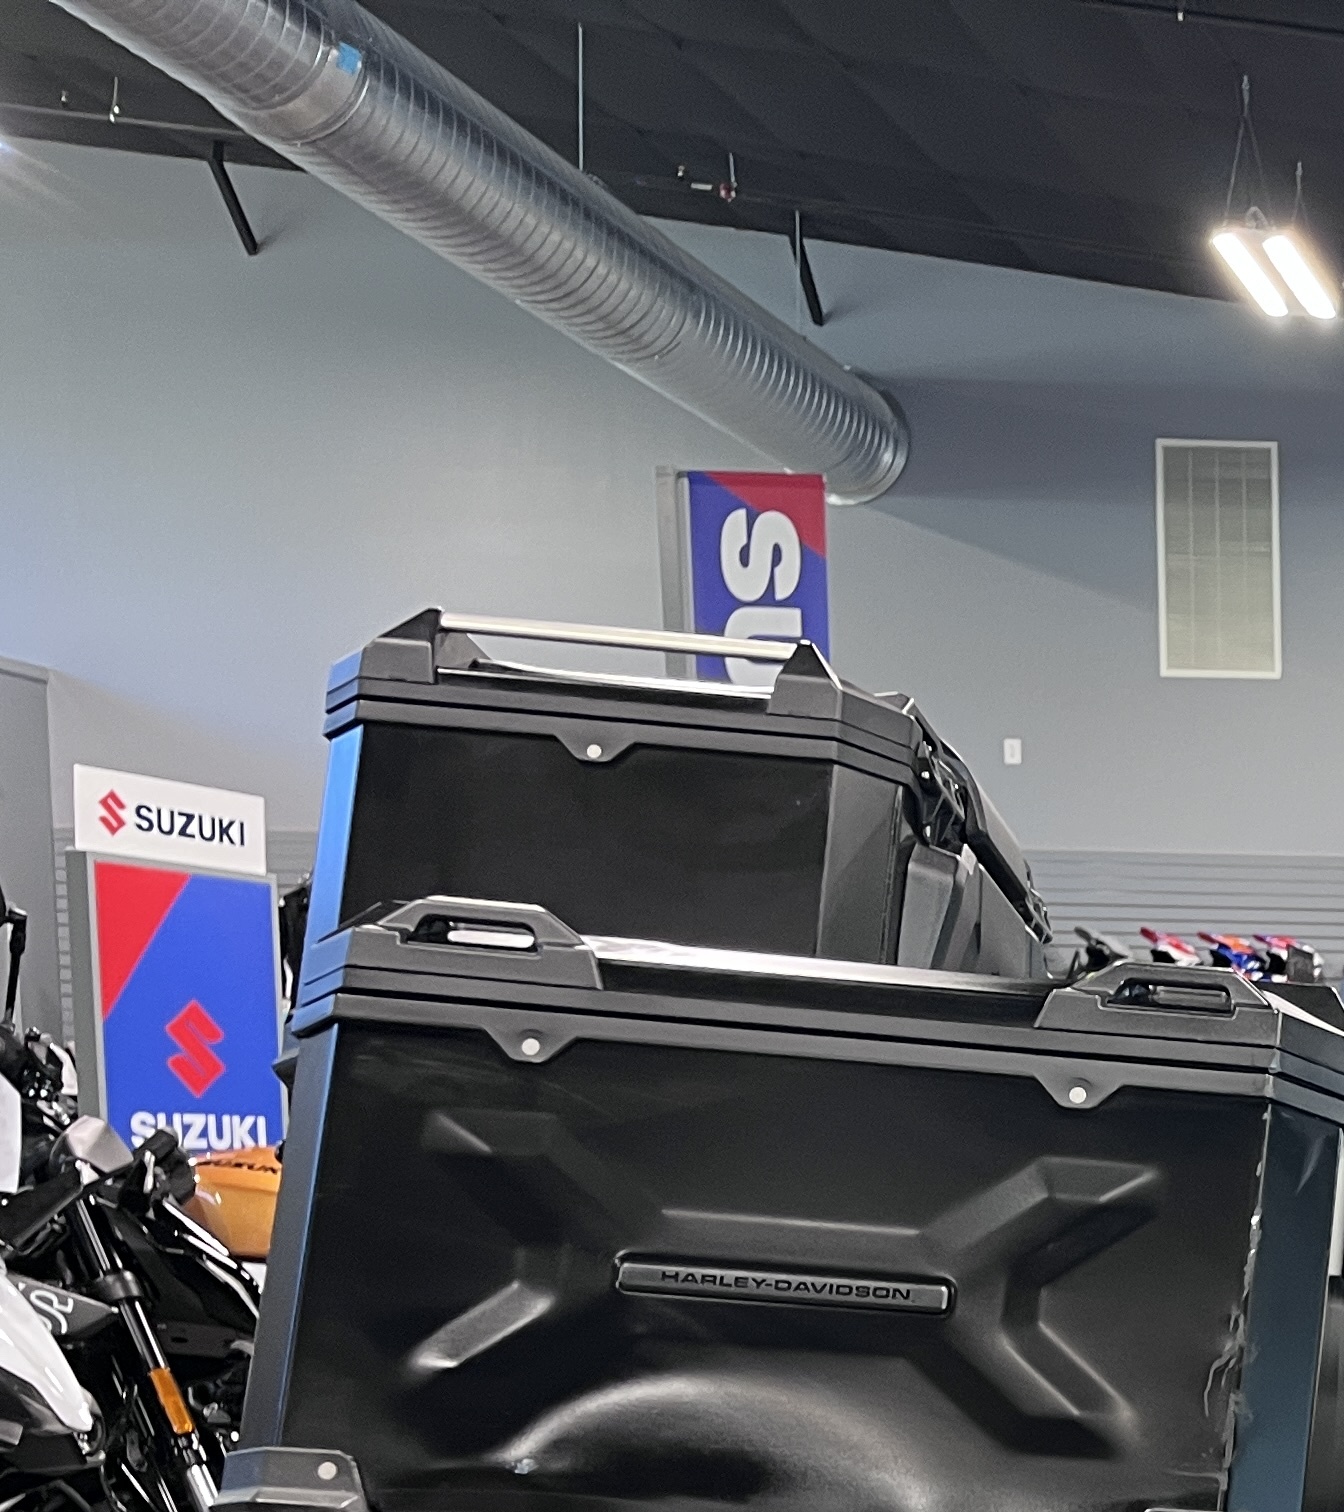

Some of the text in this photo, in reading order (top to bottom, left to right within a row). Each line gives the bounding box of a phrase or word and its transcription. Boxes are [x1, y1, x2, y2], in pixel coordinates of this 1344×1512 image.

[134, 804, 245, 847] SUZUKI
[130, 1111, 268, 1150] SUZUKI
[660, 1270, 911, 1301] HARLEY-DAVIDSON
